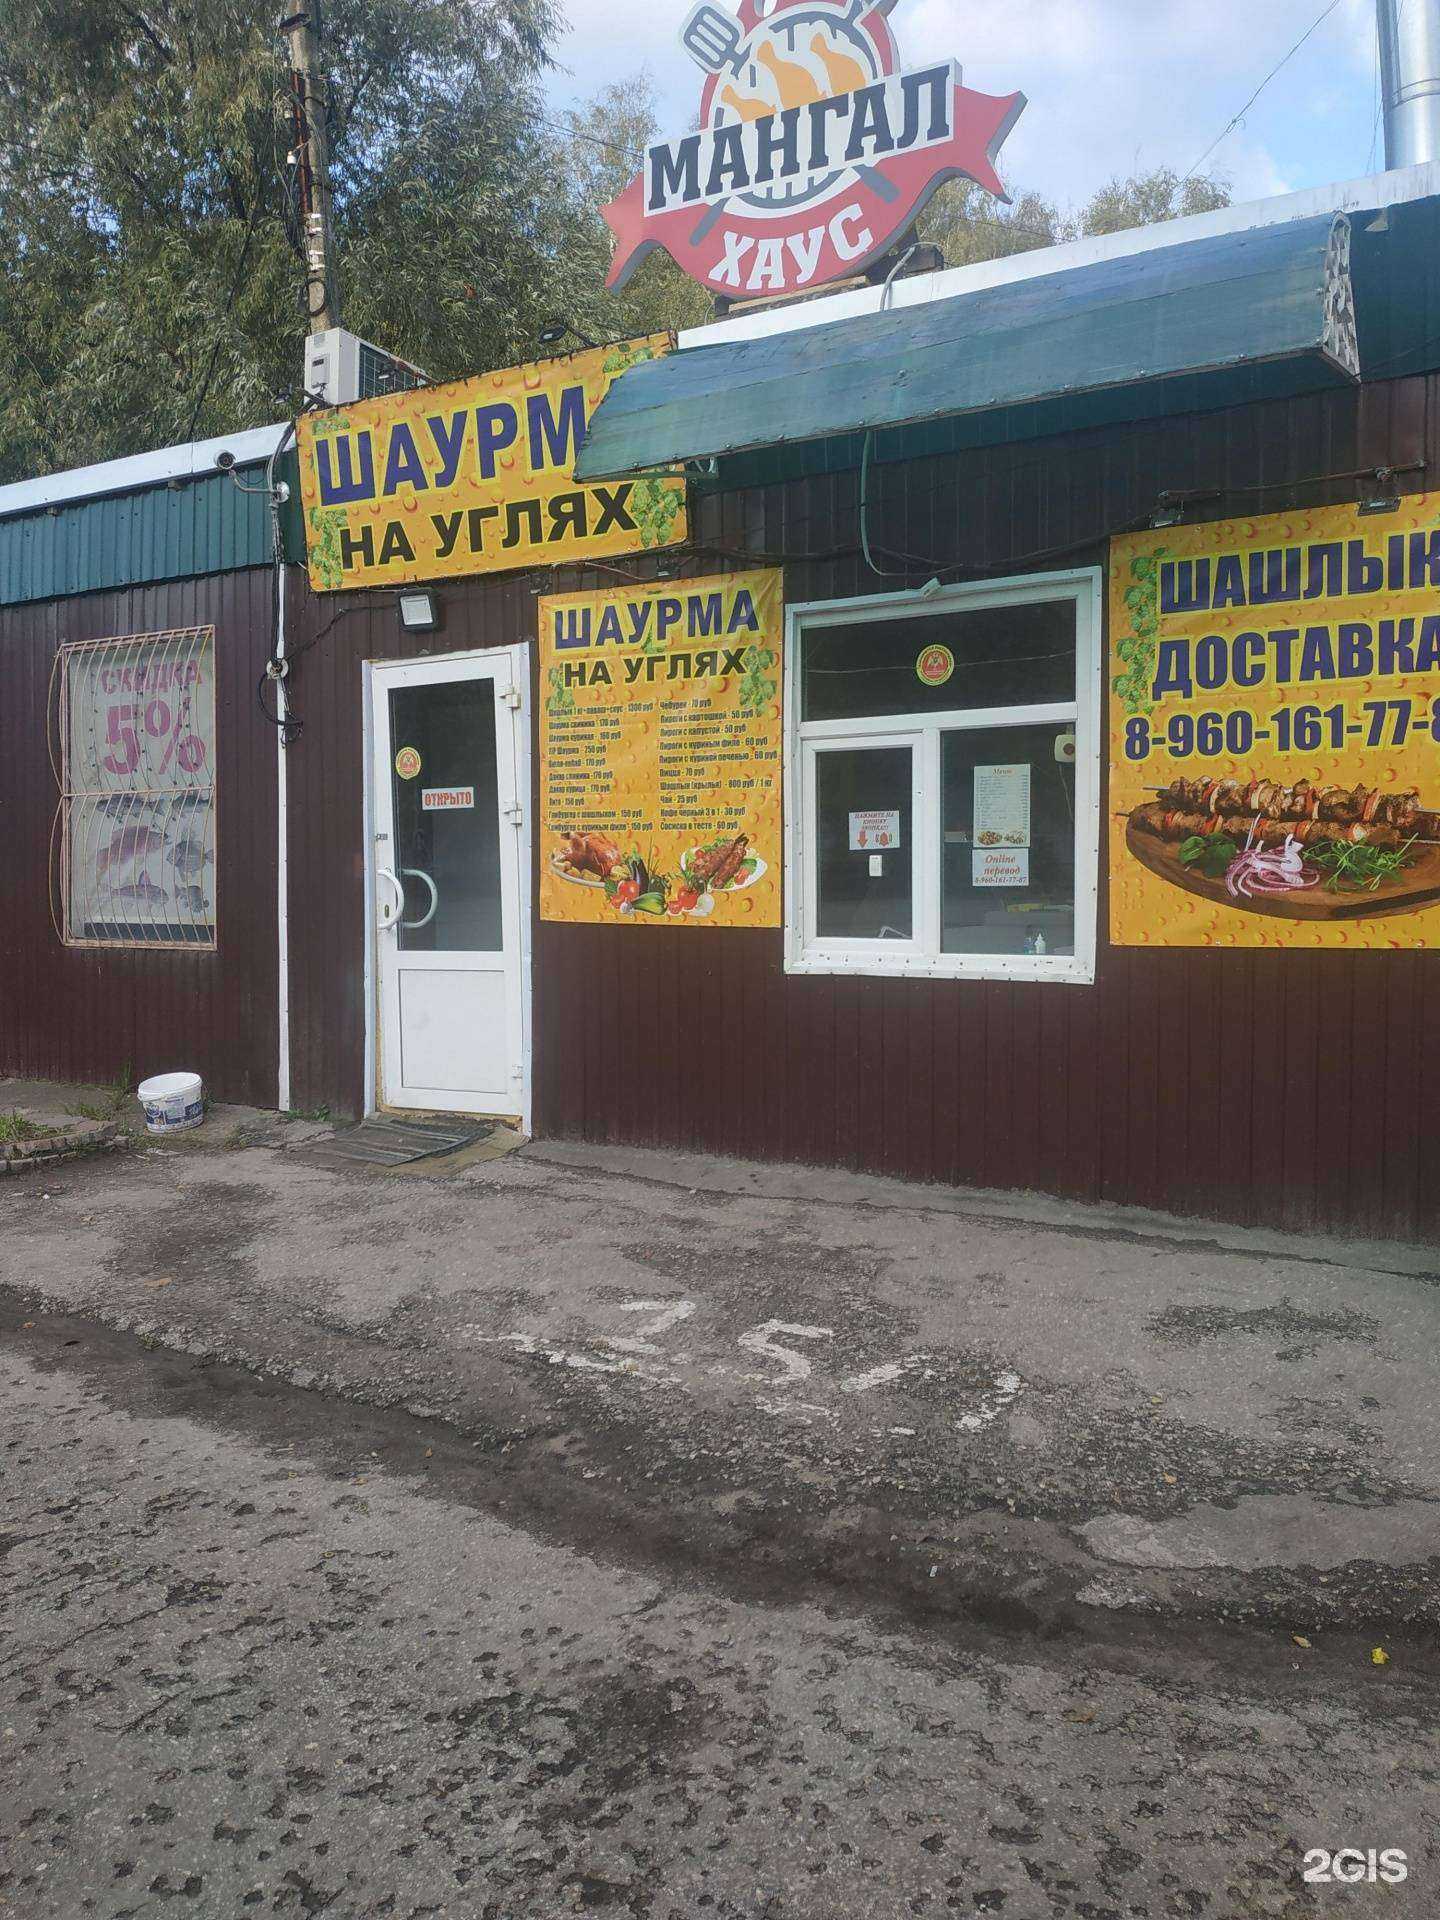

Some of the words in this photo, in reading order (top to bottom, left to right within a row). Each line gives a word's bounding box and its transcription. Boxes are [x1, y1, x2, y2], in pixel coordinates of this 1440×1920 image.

[648, 63, 951, 211] МАНГАЛ
[707, 203, 874, 290] ХАУС
[339, 521, 416, 569] НА
[431, 482, 639, 558] УГЛЯХ
[1159, 529, 1440, 614] ШАШЛЫК
[554, 589, 759, 650] ШАУРМА
[1151, 614, 1440, 701] ДОСТАВКА
[101, 659, 203, 695] СКИДКА
[564, 660, 612, 688] НА
[624, 646, 747, 683] УГЛЯХ
[103, 696, 206, 775] 5%
[424, 790, 472, 808] ОТКРЫТО
[985, 854, 1016, 864] Online
